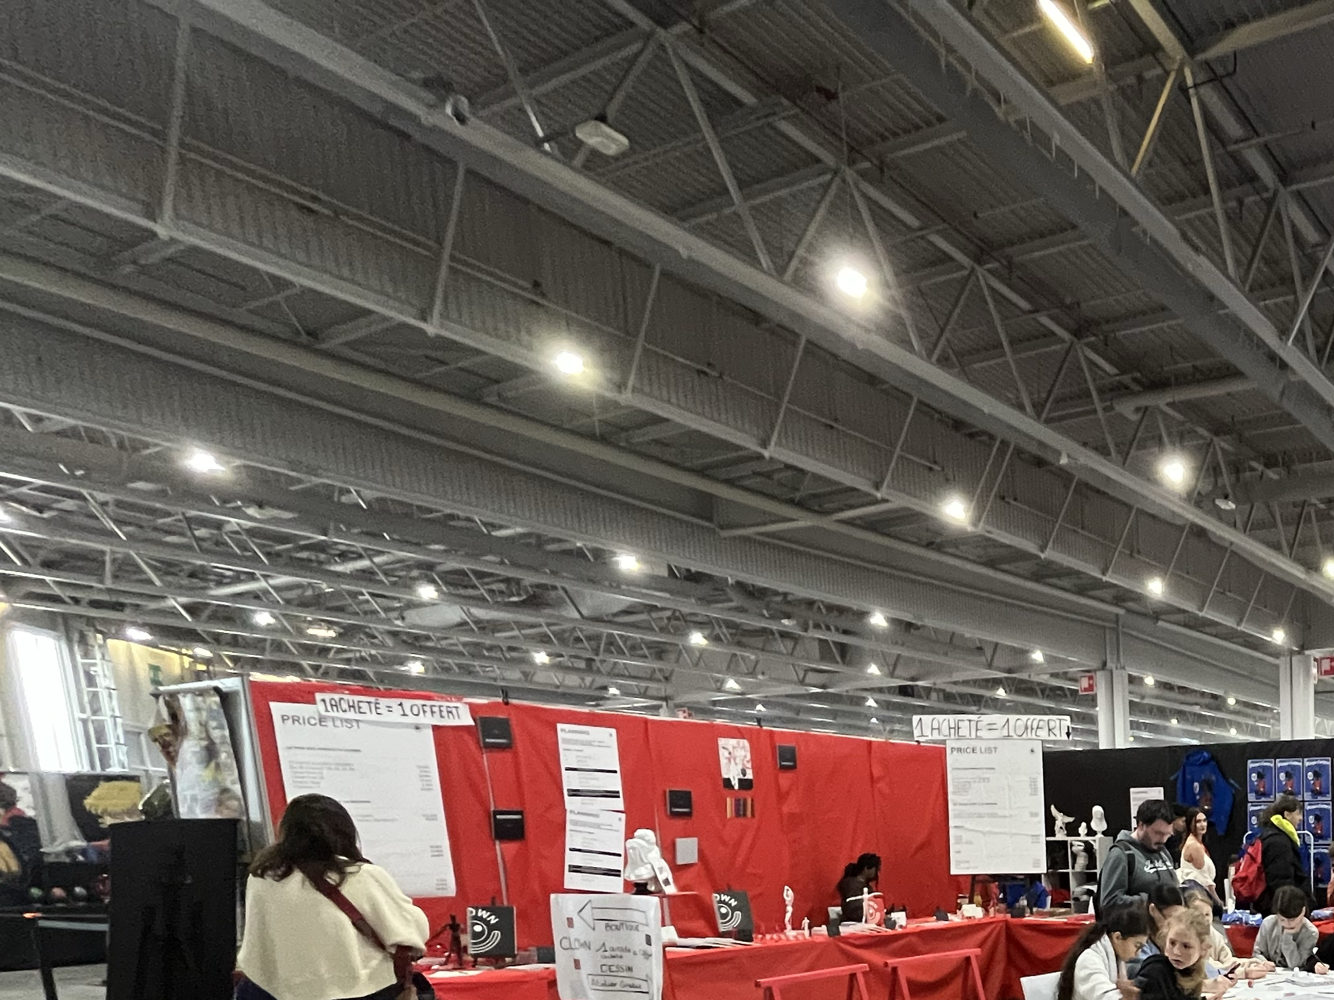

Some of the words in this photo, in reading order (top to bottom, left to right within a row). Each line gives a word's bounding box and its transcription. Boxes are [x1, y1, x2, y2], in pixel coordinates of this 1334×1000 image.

[281, 714, 328, 727] PRICE
[332, 717, 362, 729] LIST
[930, 716, 984, 738] ACHETÉ
[560, 937, 591, 950] CLOWN
